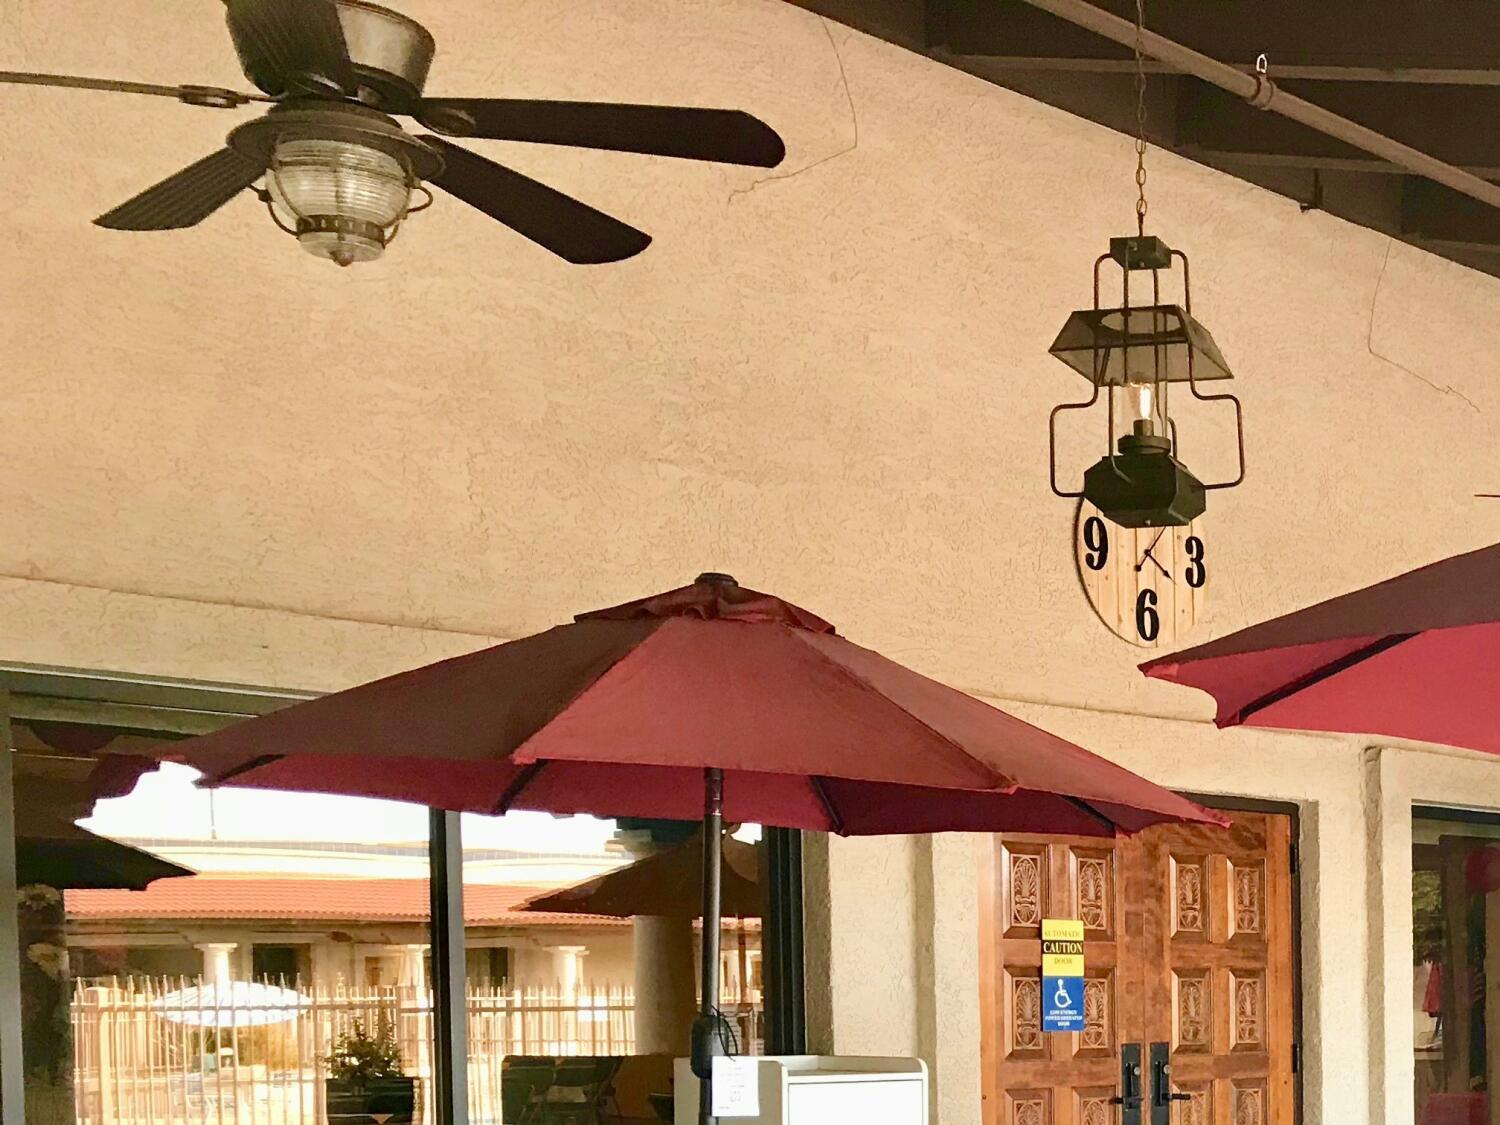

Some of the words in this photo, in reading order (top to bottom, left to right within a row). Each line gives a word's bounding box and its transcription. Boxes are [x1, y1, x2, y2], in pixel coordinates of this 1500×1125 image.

[1084, 517, 1108, 570] 9
[1185, 536, 1206, 588] 3
[1136, 589, 1159, 641] 6
[1043, 942, 1082, 953] CAUTION
